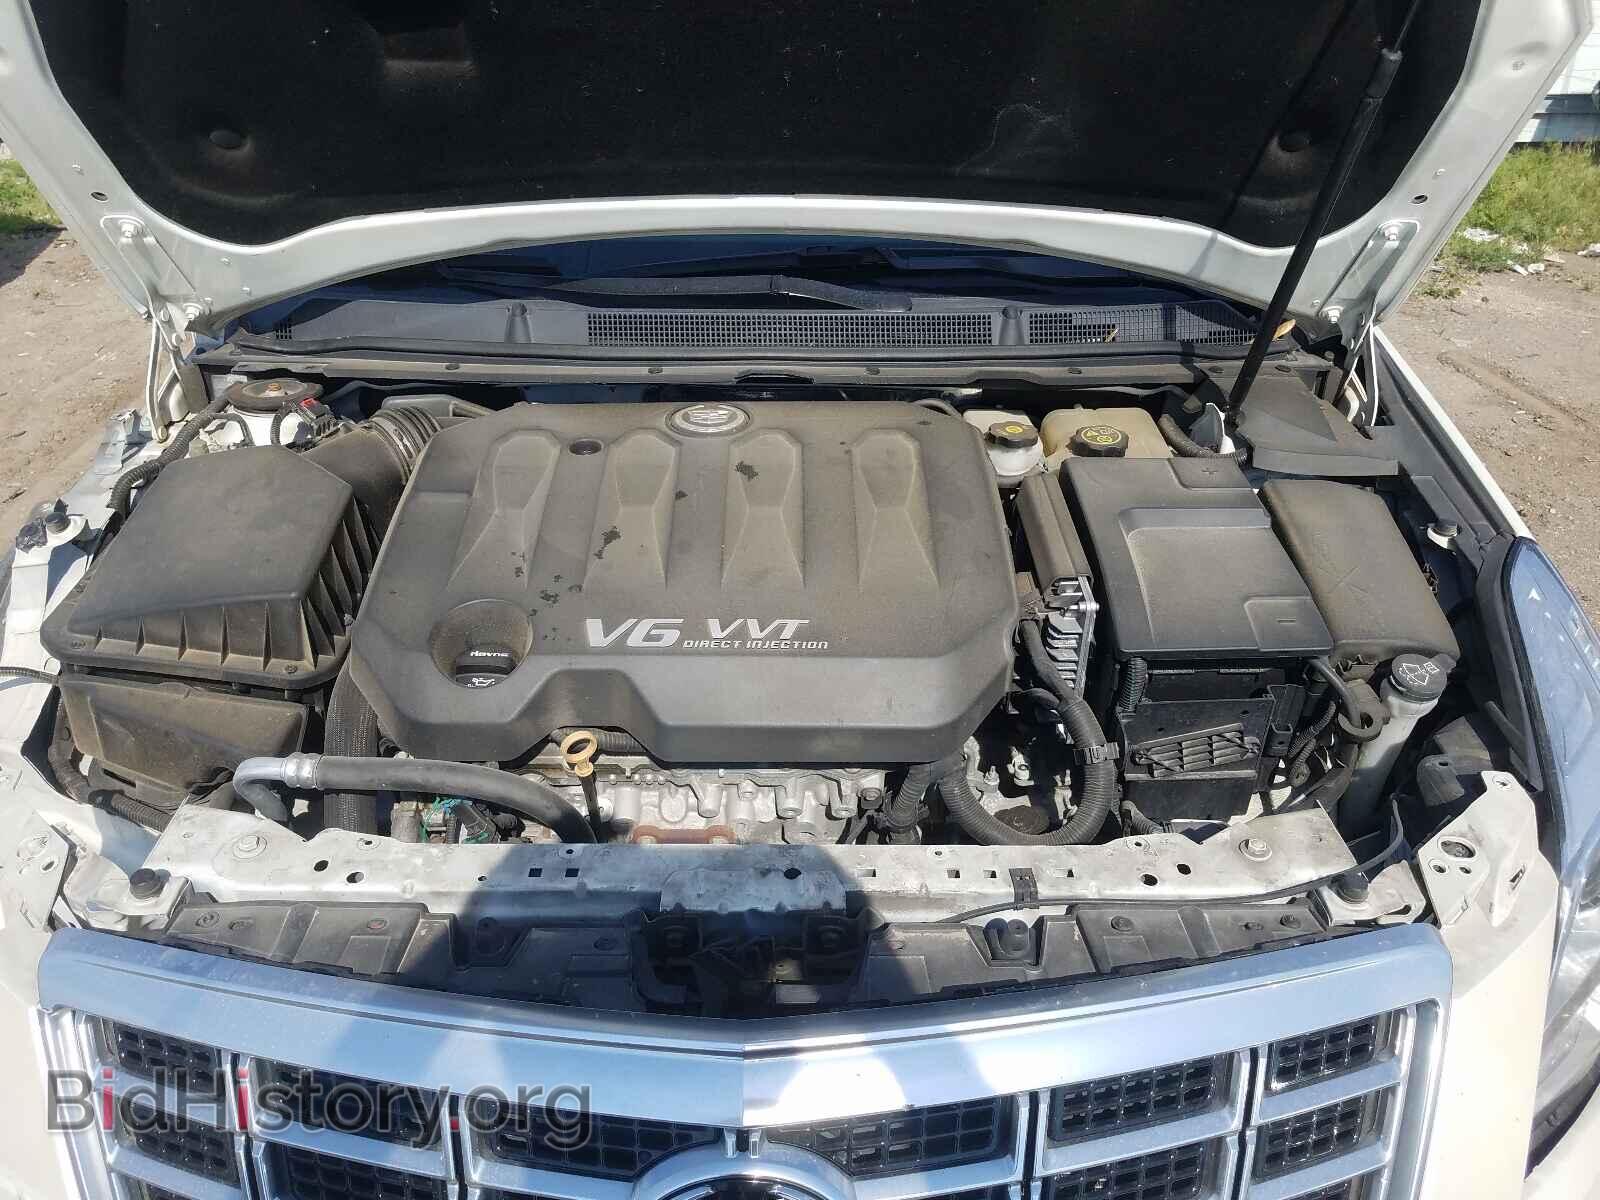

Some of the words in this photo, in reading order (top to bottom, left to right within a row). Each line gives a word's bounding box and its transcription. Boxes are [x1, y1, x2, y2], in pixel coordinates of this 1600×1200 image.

[585, 618, 684, 648] V6
[706, 618, 810, 640] VVT
[682, 640, 742, 649] DIRECT
[745, 640, 829, 650] INJECTION
